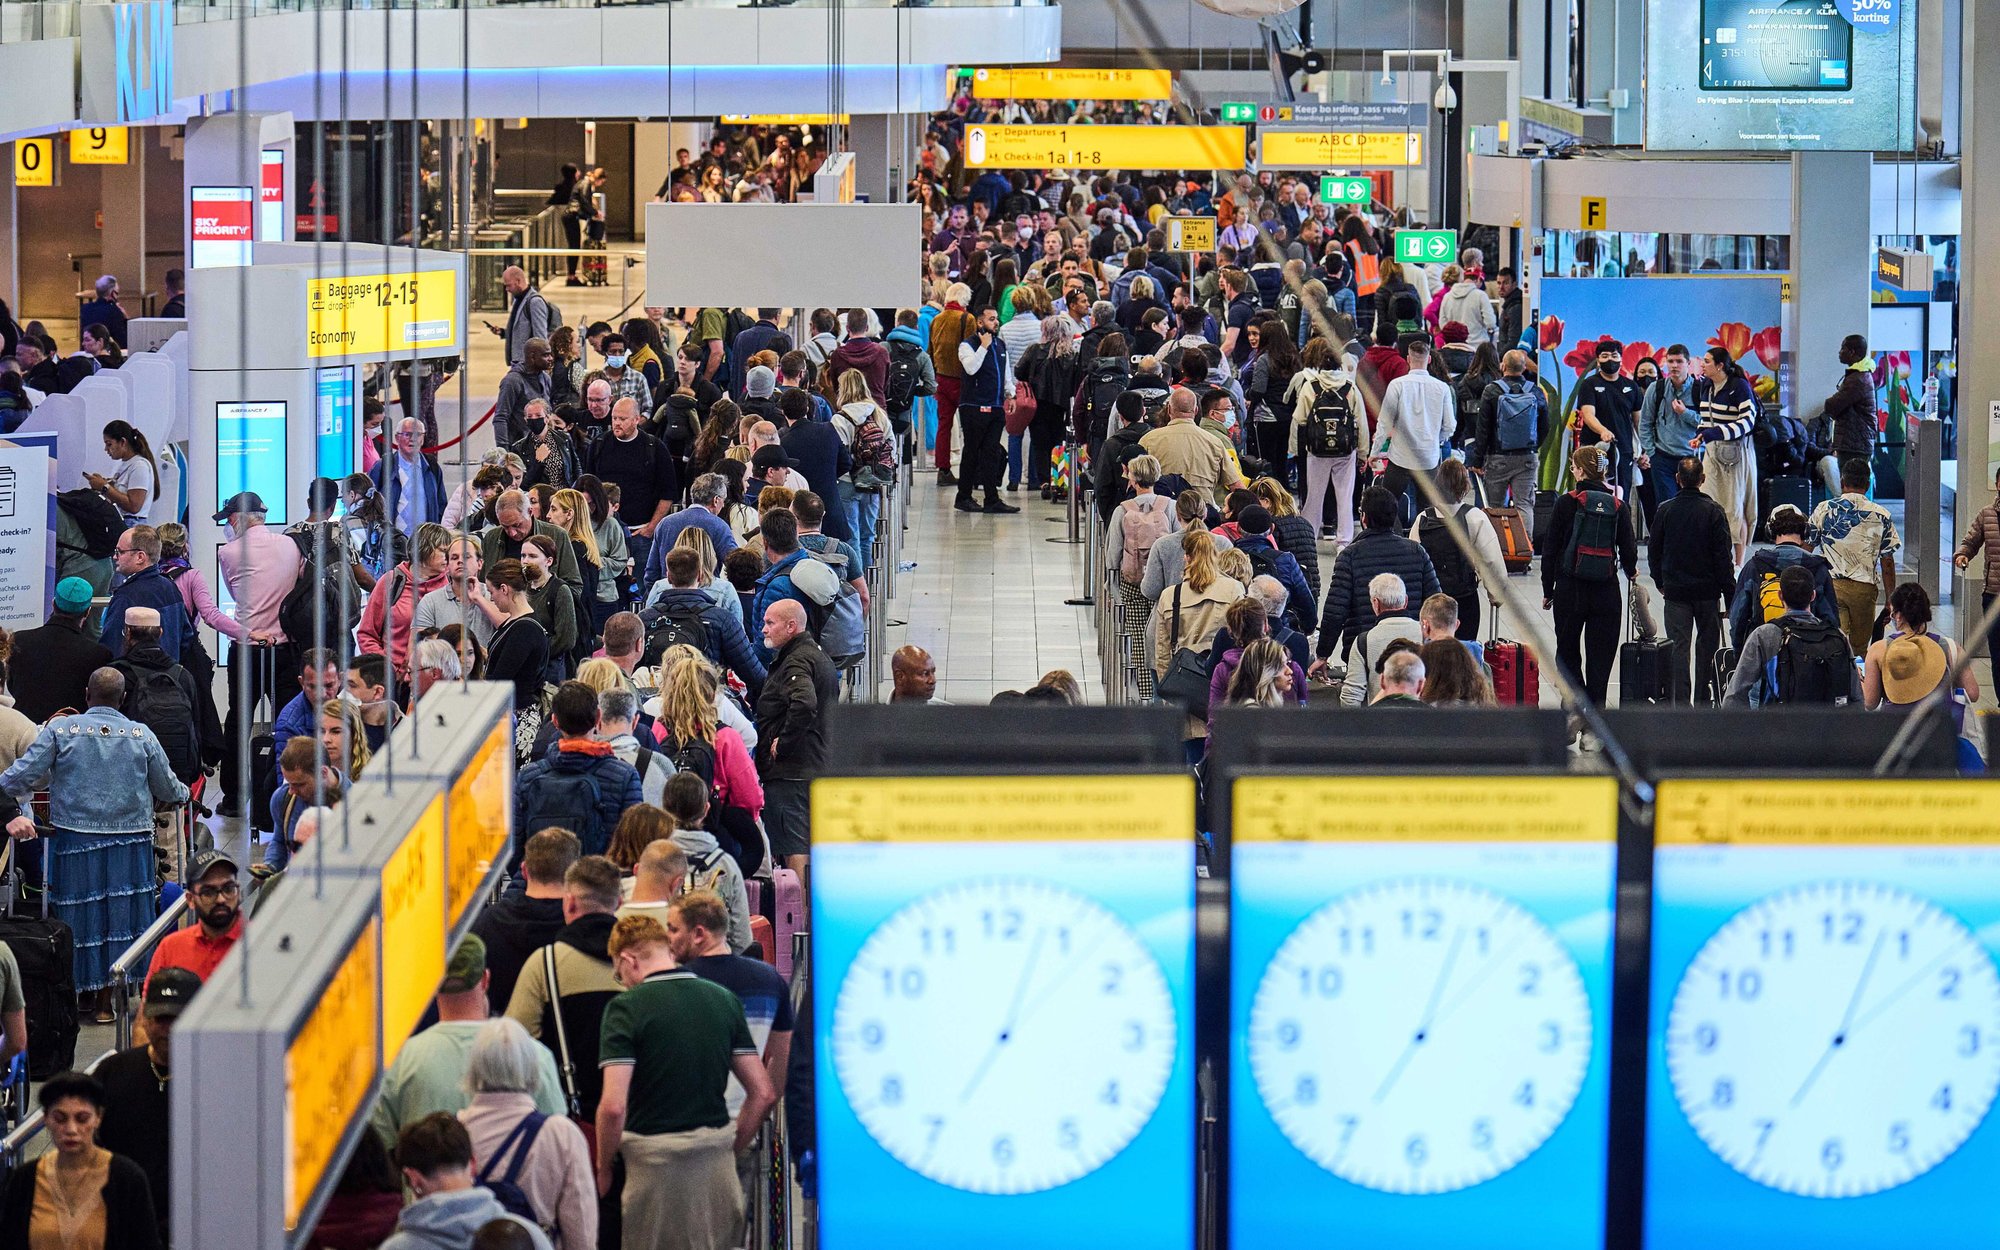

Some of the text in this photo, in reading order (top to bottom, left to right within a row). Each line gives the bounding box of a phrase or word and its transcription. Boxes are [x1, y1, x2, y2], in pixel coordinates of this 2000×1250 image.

[1852, 0, 1891, 11] 50%
[1853, 12, 1890, 24] korting
[115, 0, 173, 123] KLM
[1295, 104, 1318, 115] Keep
[1383, 104, 1408, 115] ready
[1708, 97, 1727, 105] Flying
[1782, 97, 1806, 105] Express
[90, 128, 107, 149] 9
[1004, 128, 1066, 143] Departures 1
[1320, 135, 1329, 145] A
[1332, 135, 1340, 145] B
[1343, 135, 1352, 145] C
[1358, 135, 1367, 145] D
[1739, 132, 1776, 140] Voorwaarden
[1789, 133, 1820, 141] toepassing
[22, 143, 40, 170] 0
[1004, 151, 1101, 164] Check-in 1a 1-8
[194, 218, 219, 227] SKY
[1588, 202, 1600, 226] F
[194, 226, 248, 235] PRIORITY
[328, 300, 355, 311] drop-off
[329, 281, 418, 306] Baggage 12-15
[310, 330, 355, 345] Economy
[0, 528, 32, 536] check-in?
[21, 584, 31, 593] app
[6, 612, 35, 620] documents
[981, 910, 1023, 941] 12
[1401, 910, 1443, 940] 12
[1822, 912, 1864, 943] 12
[921, 928, 955, 956] 11
[1059, 928, 1071, 956] 1
[1339, 927, 1374, 956] 11
[1478, 927, 1489, 955] 1
[1759, 930, 1793, 959] 11
[1898, 930, 1910, 959] 1
[883, 967, 926, 999] 10
[1100, 964, 1124, 996] 2
[1300, 967, 1343, 999] 10
[1519, 965, 1541, 997] 2
[1718, 970, 1762, 1001] 10
[1940, 968, 1961, 1000] 2
[862, 1020, 885, 1052] 9
[1122, 1021, 1146, 1052] 3
[1277, 1020, 1301, 1052] 9
[1539, 1022, 1561, 1053] 3
[1696, 1024, 1718, 1055] 9
[1958, 1025, 1980, 1057] 3
[881, 1076, 904, 1107] 8
[1100, 1080, 1120, 1107] 4
[1295, 1075, 1318, 1107] 8
[1514, 1080, 1536, 1108] 4
[1712, 1079, 1733, 1109] 8
[1932, 1084, 1952, 1111] 4
[924, 1114, 946, 1144] 7
[1058, 1118, 1080, 1150] 5
[1338, 1114, 1359, 1145] 7
[1472, 1117, 1493, 1149] 5
[1755, 1119, 1775, 1148] 7
[1891, 1122, 1909, 1153] 5
[992, 1135, 1015, 1167] 6
[1405, 1134, 1428, 1167] 6
[1821, 1139, 1843, 1171] 6
